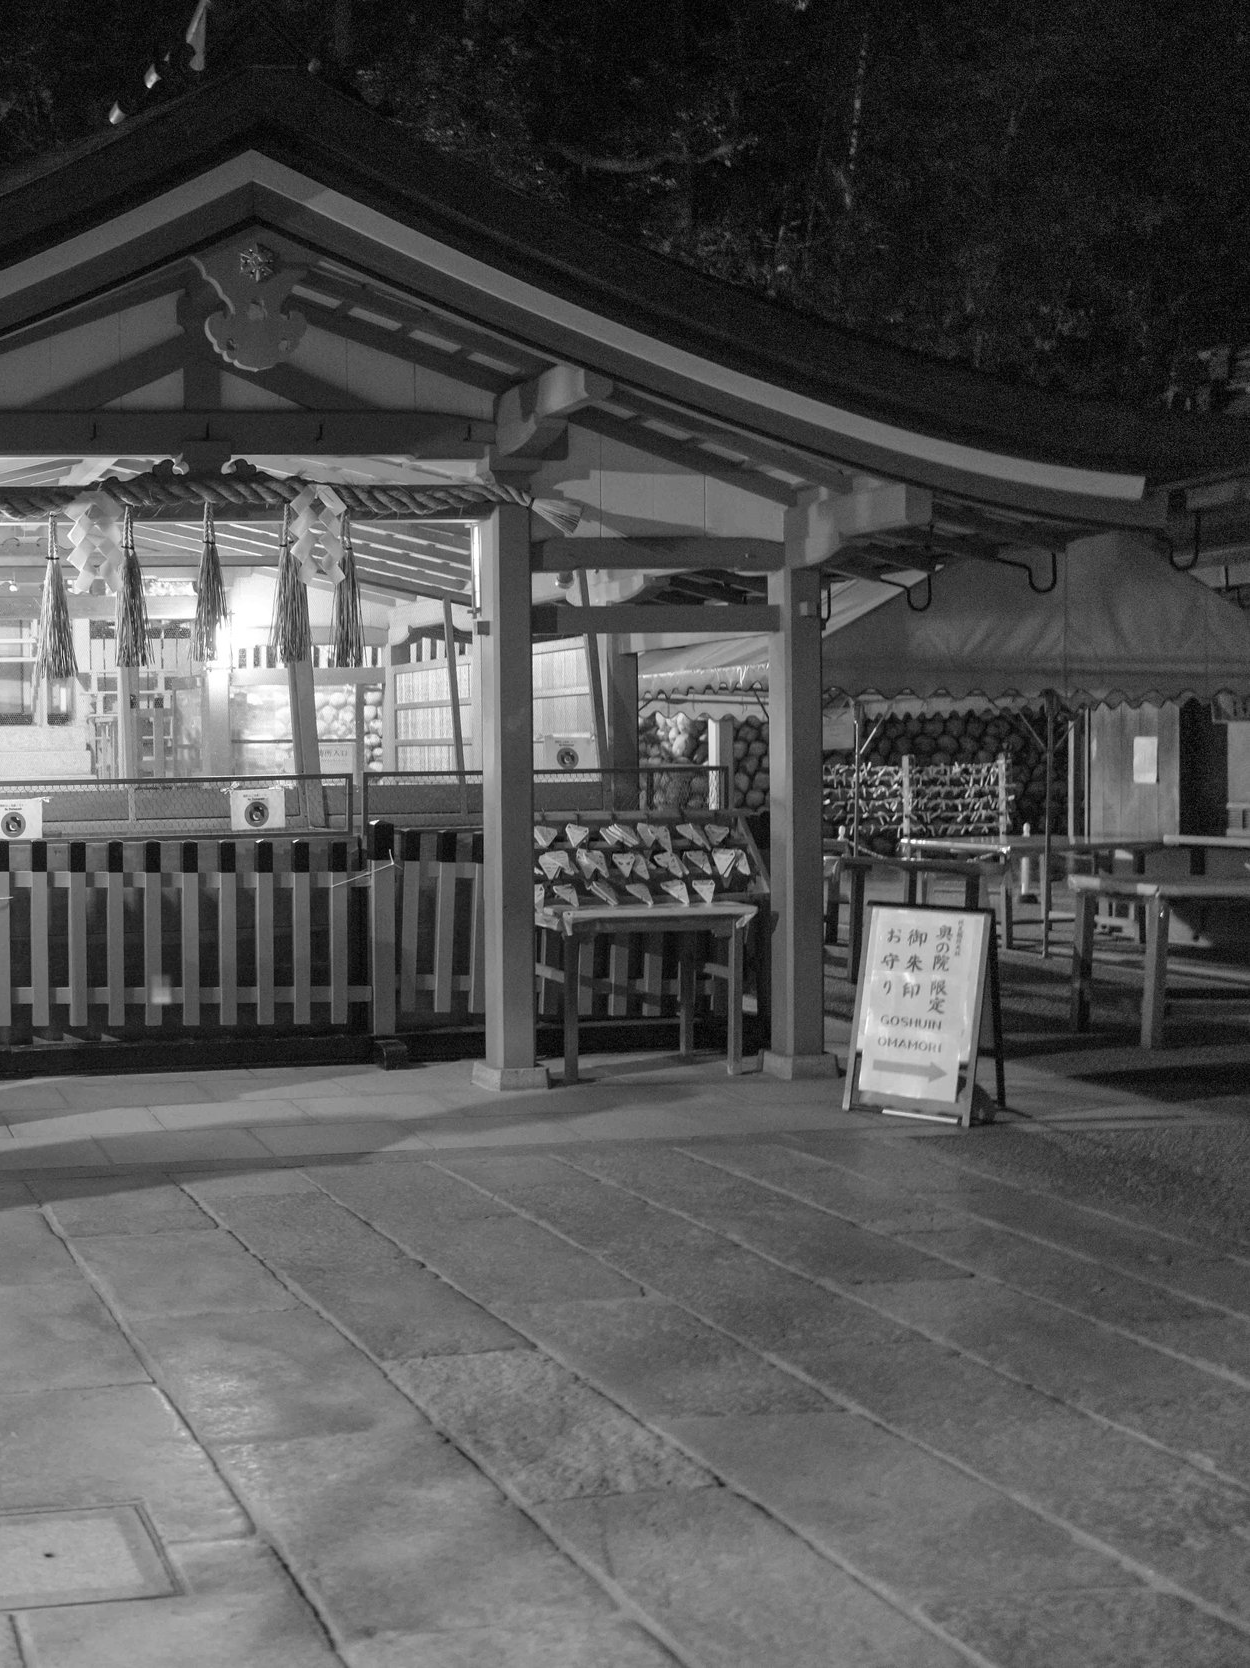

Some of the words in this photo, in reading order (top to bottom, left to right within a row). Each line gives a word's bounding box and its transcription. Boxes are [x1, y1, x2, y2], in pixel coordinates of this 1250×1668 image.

[880, 927, 903, 996] お守り
[902, 928, 929, 999] 御朱印
[880, 1015, 942, 1030] GOSHUIN
[878, 1037, 942, 1053] OMAMORI
